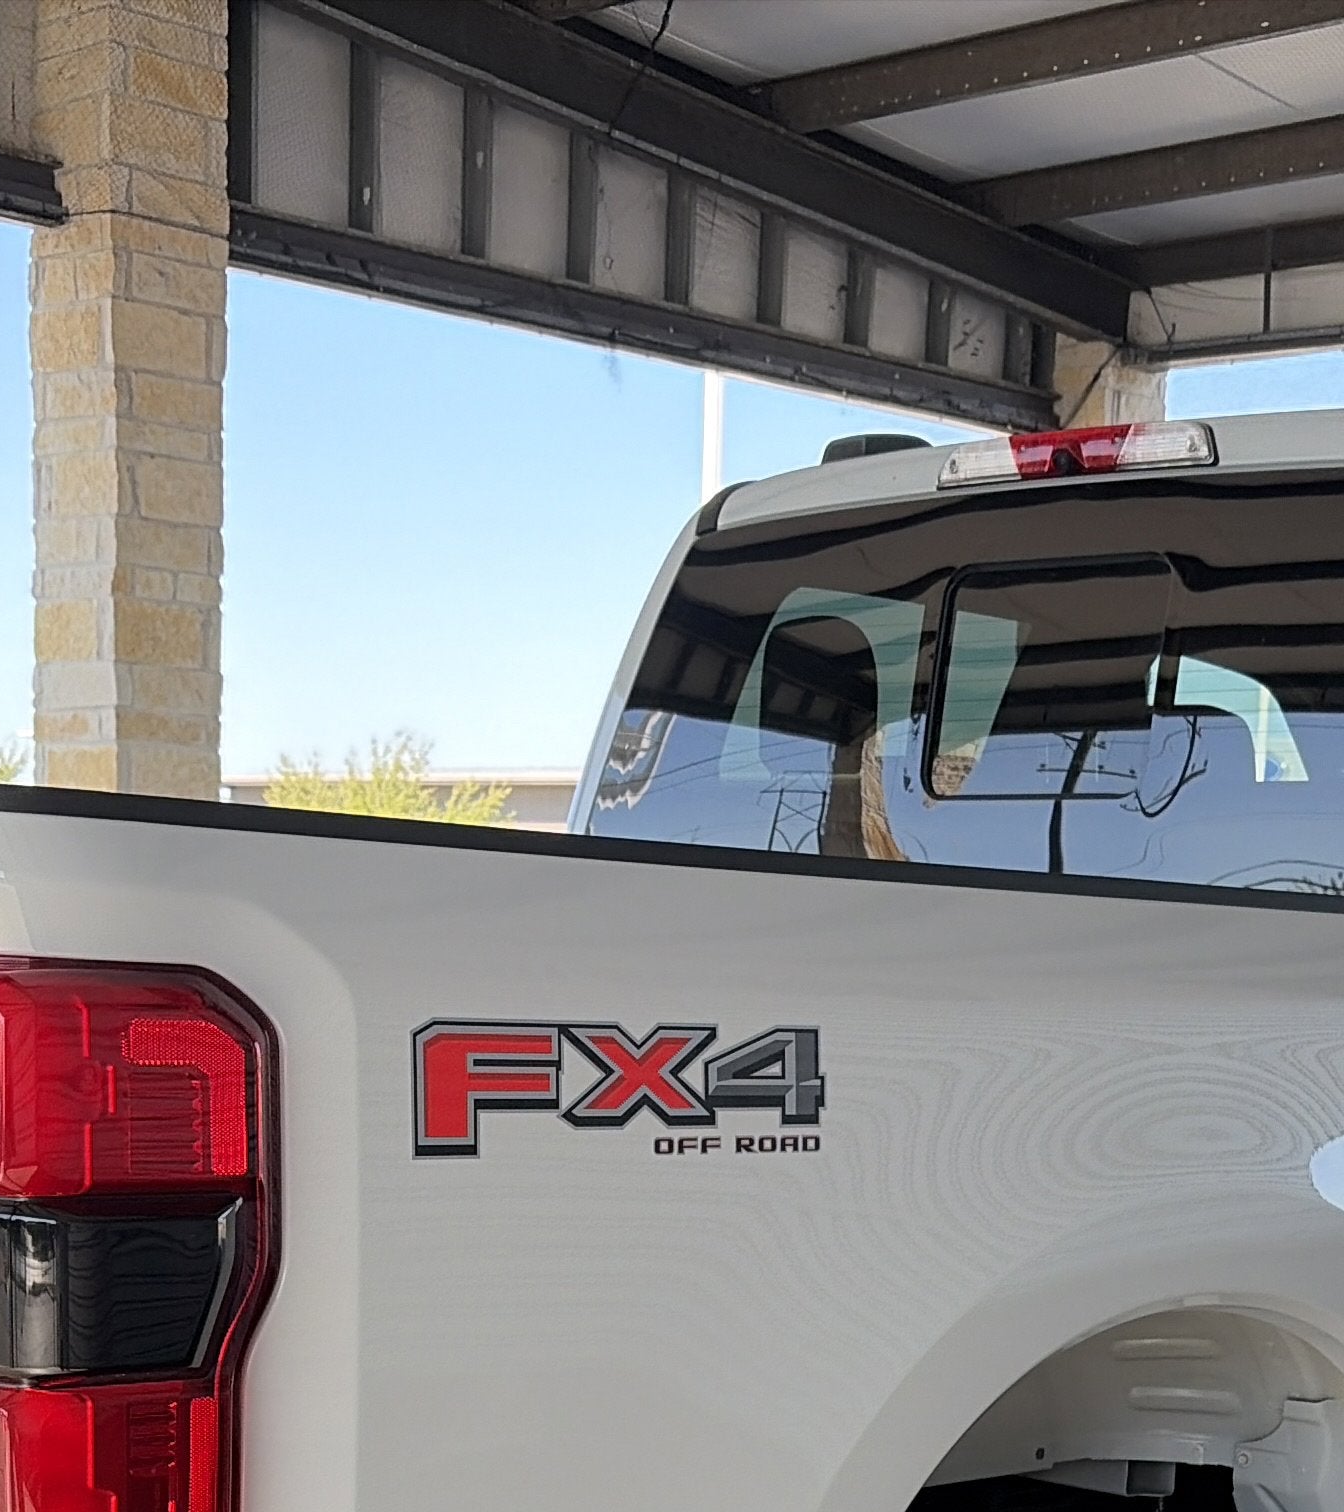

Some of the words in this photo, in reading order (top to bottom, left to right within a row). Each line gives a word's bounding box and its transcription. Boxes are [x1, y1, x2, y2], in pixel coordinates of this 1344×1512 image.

[411, 1018, 827, 1159] FX4
[654, 1135, 722, 1156] OFF
[735, 1134, 821, 1154] ROAD
